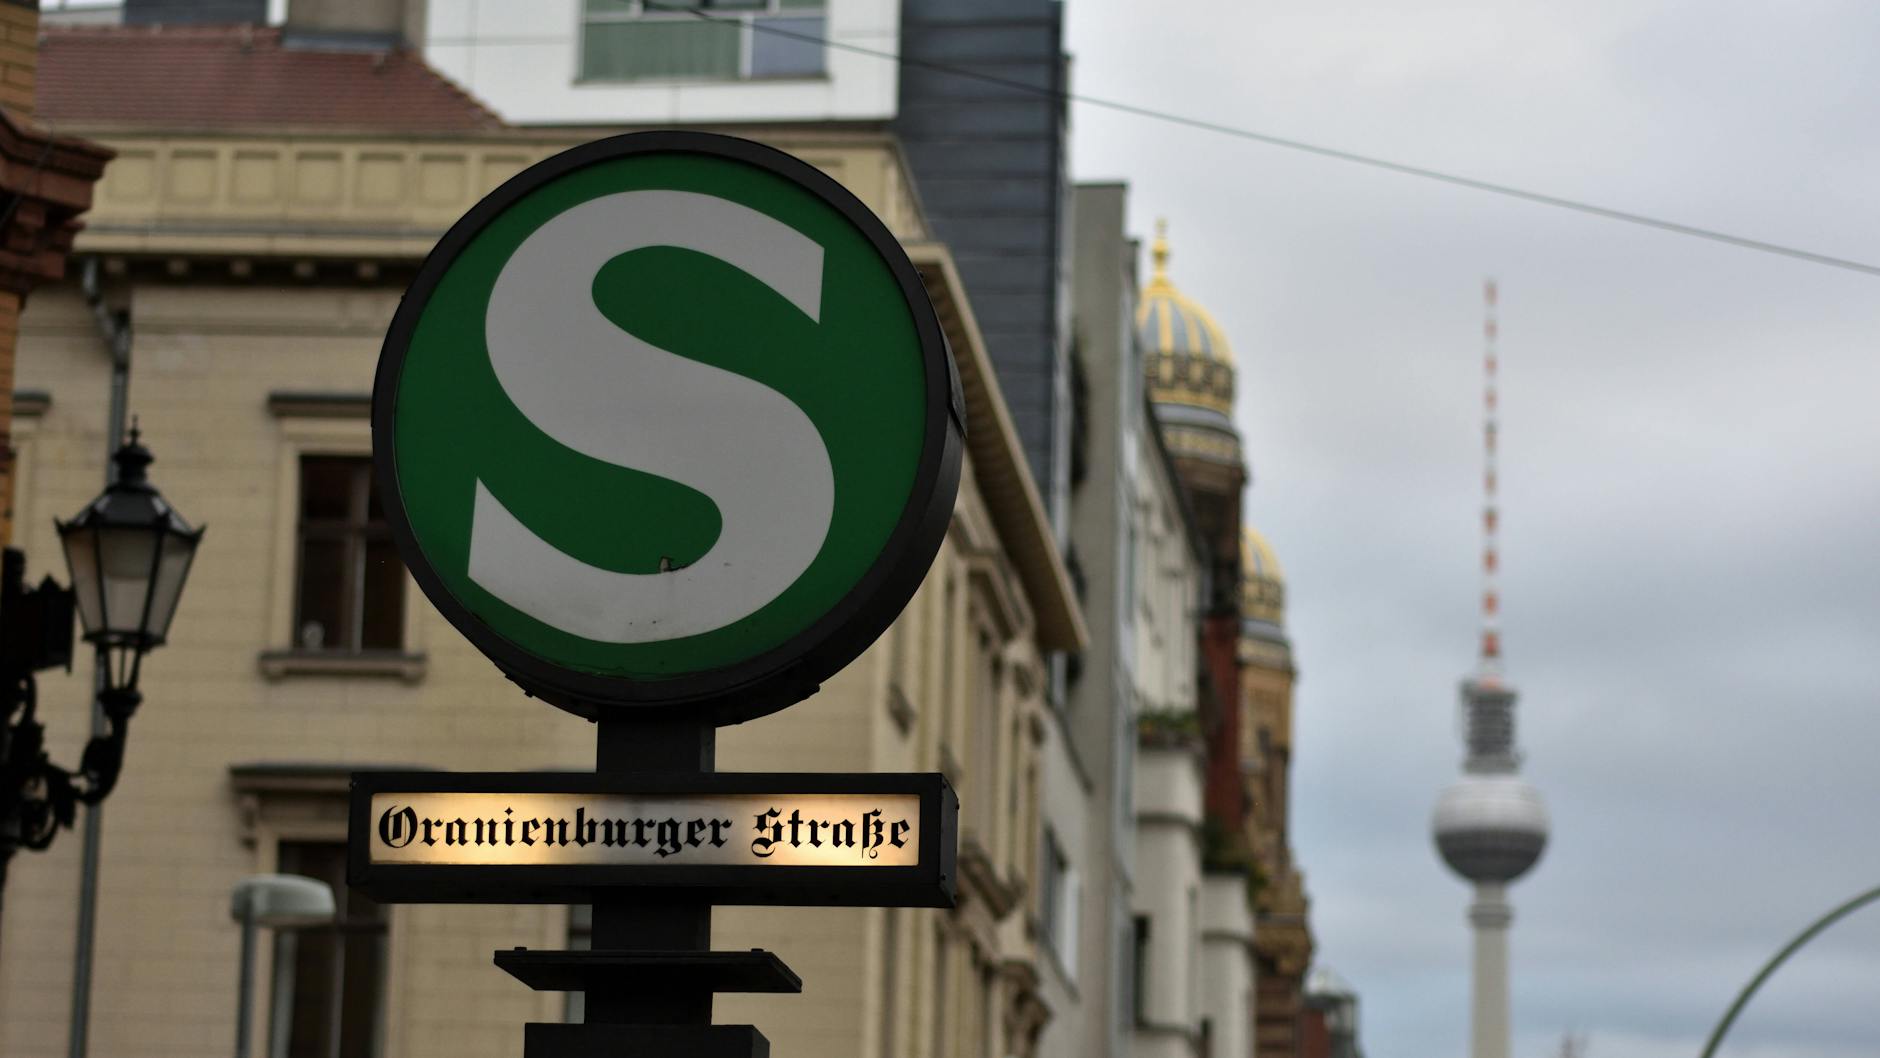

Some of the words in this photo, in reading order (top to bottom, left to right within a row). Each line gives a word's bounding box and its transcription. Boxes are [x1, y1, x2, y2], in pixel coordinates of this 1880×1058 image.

[467, 189, 834, 643] S
[379, 805, 733, 858] Oranienburger
[752, 807, 911, 859] Straße
